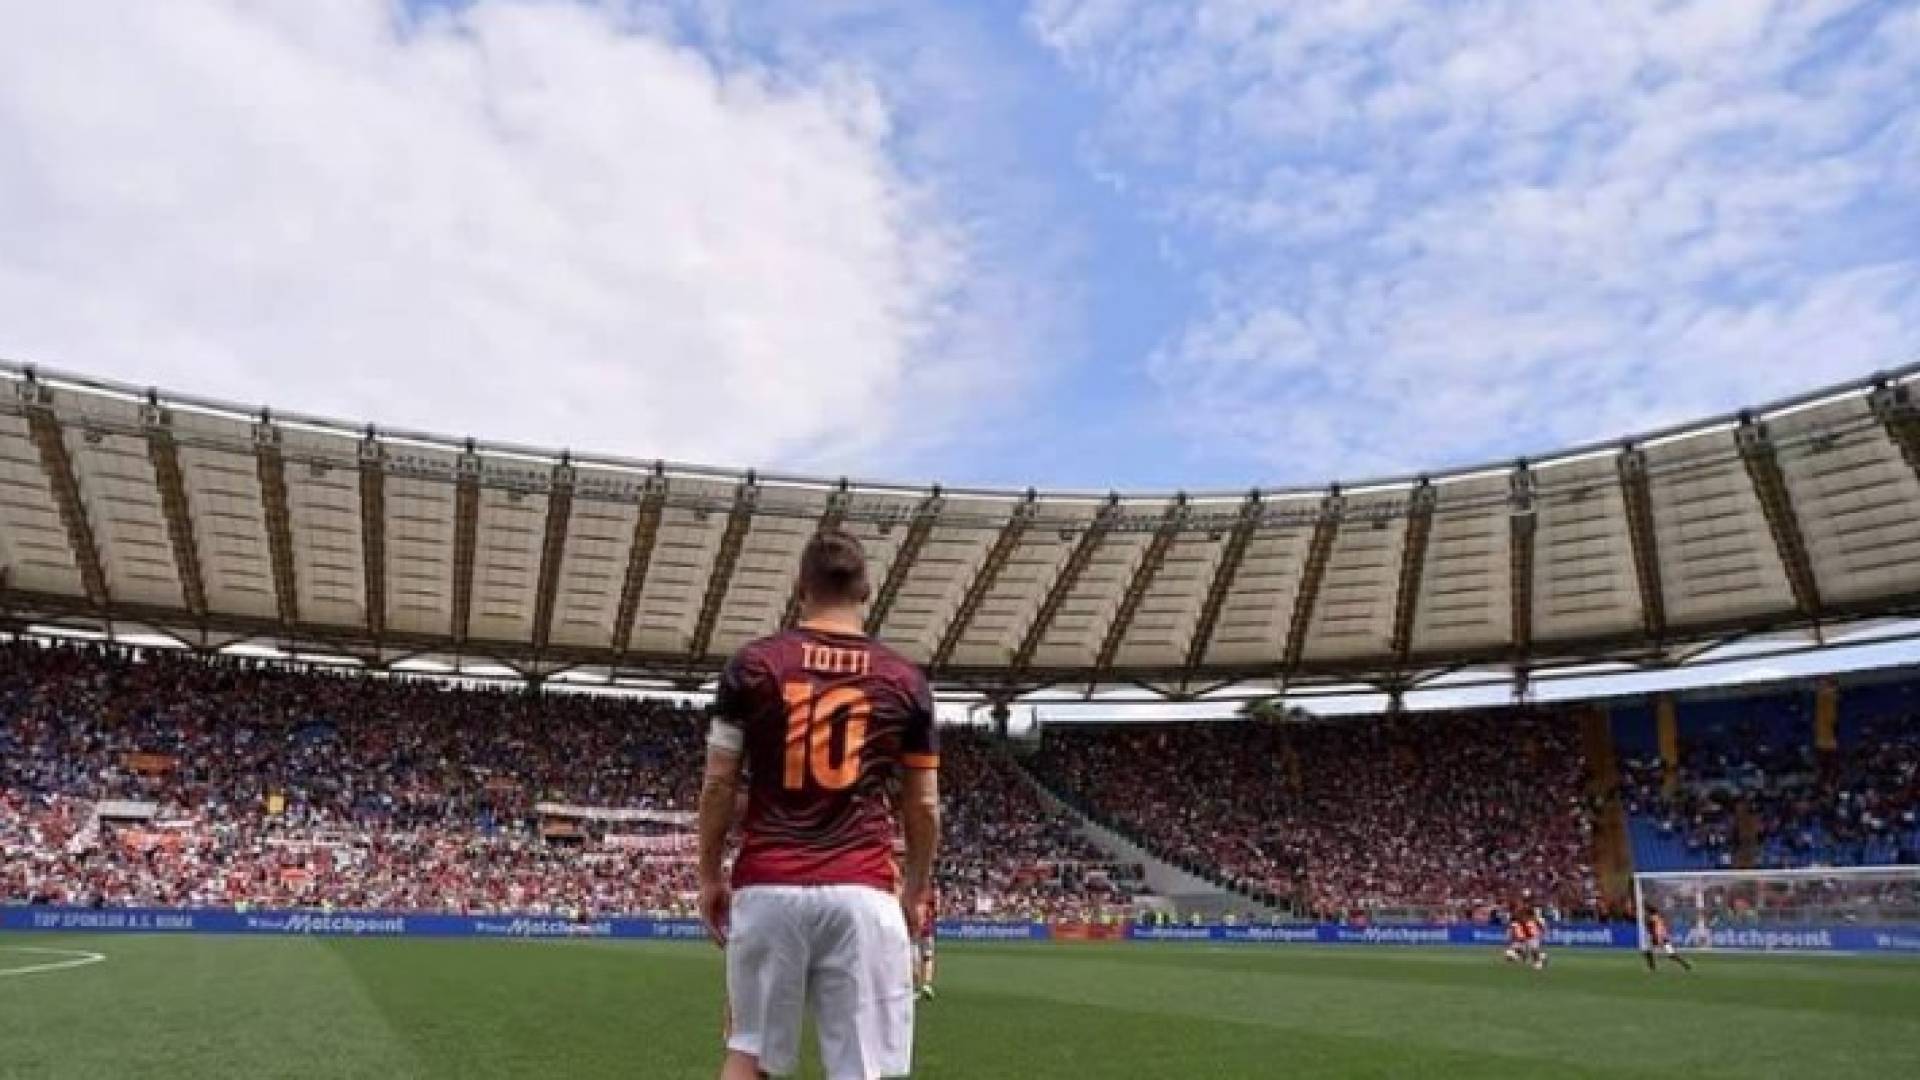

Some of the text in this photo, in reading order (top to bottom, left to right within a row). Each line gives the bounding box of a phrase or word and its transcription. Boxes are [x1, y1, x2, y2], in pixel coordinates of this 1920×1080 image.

[801, 641, 870, 676] TOTTI
[783, 682, 872, 789] 10
[34, 911, 60, 927] TOP
[283, 914, 405, 934] Matchpoint
[1685, 928, 1832, 950] Matchpoint
